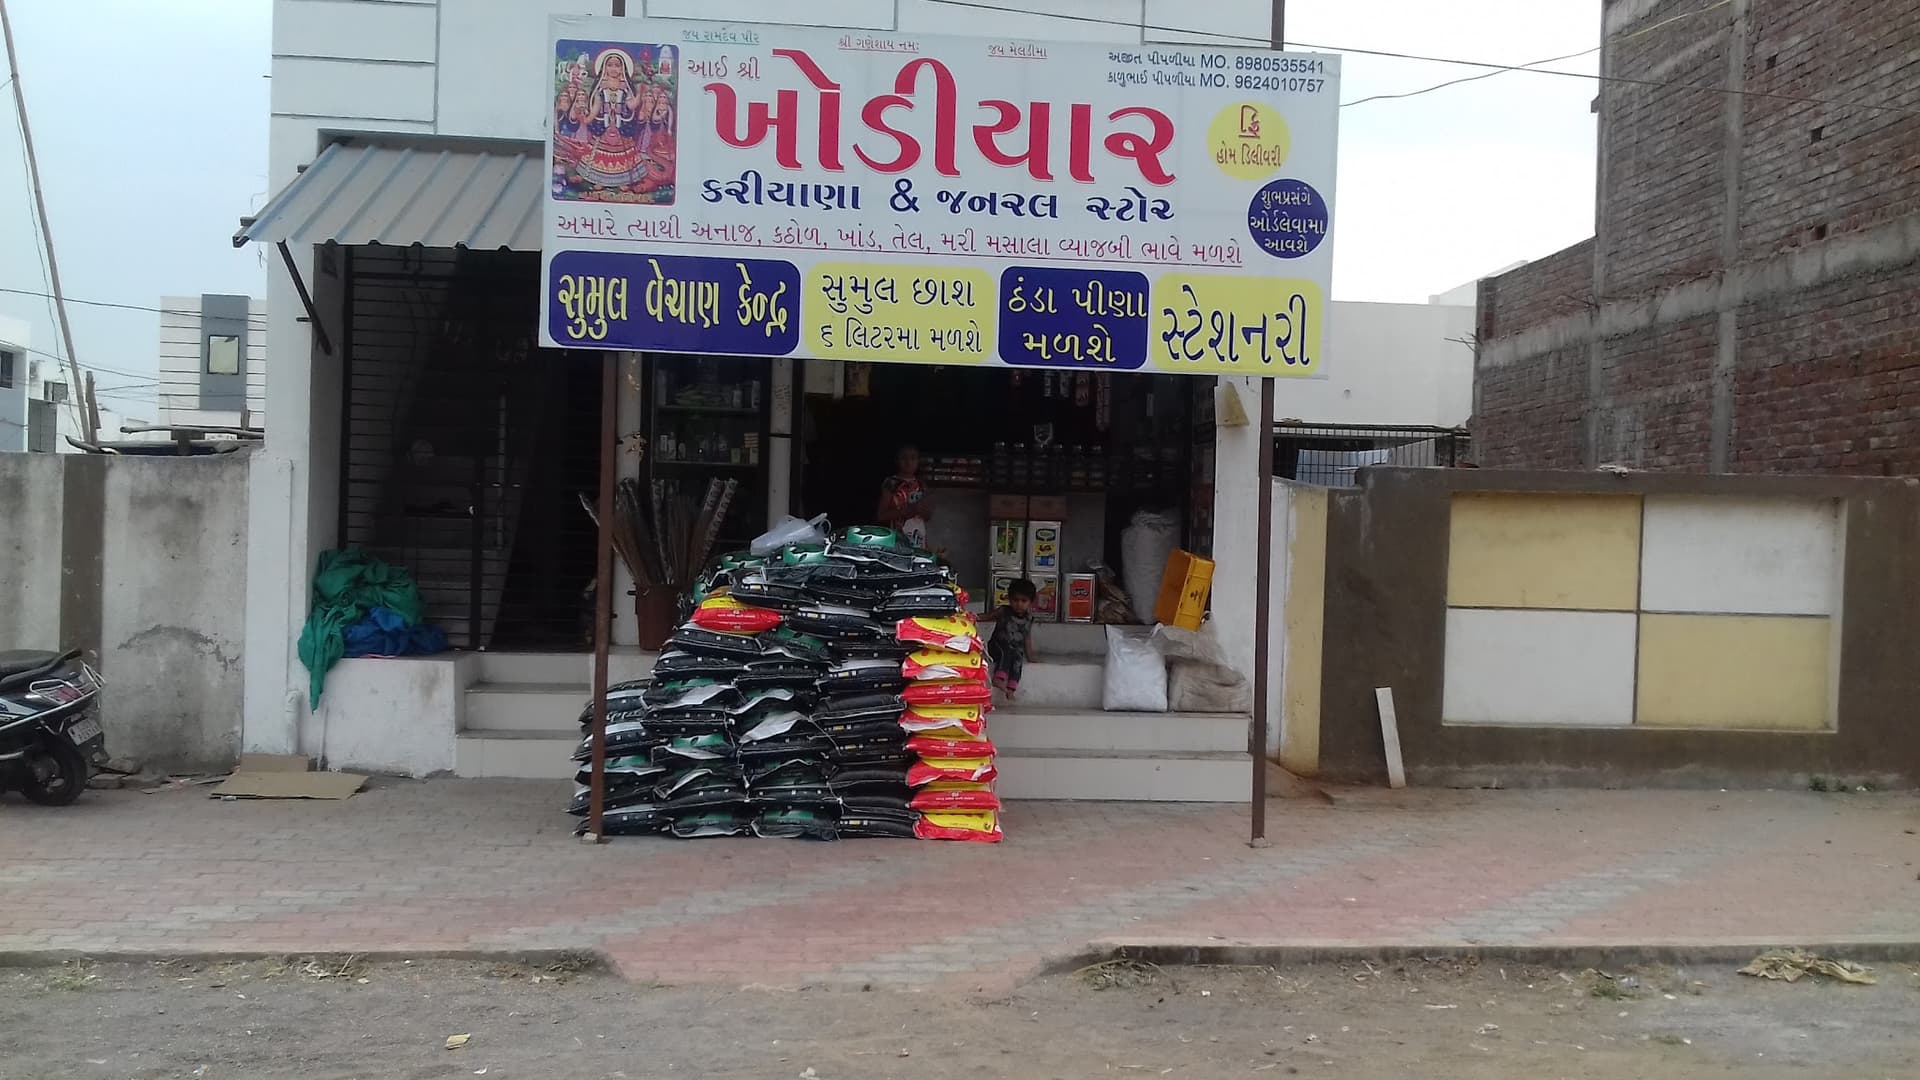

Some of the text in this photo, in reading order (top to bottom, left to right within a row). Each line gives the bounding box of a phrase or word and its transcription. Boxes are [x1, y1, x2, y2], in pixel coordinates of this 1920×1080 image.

[688, 55, 760, 79] આઈ શ્રી
[1200, 53, 1230, 70] MO.
[1235, 56, 1324, 75] 8980535541
[1200, 72, 1230, 88] MO.
[1235, 74, 1325, 93] 9624010757
[703, 48, 1176, 186] ખોડીયાર
[1216, 140, 1281, 167] હોમ ડિલીવરી
[701, 169, 1176, 223] કરીયાણા & જનરલ સ્ટોર
[557, 210, 617, 237] અમારે
[627, 215, 681, 240] ત્યાથી
[691, 221, 763, 247] અનાજ,
[941, 227, 976, 253] મરી
[986, 234, 1051, 256] મસાલા
[1058, 234, 1132, 260] વ્યાજબી
[1141, 239, 1183, 262] ભાવે
[1192, 237, 1243, 264] મળશે
[1264, 234, 1309, 253] આવશે
[558, 258, 789, 340] સુમુલ વેચાણ કેન્દ્ર
[821, 273, 976, 315] સુમુલ છાશ
[1007, 276, 1149, 318] ઠંડા પીણા
[845, 316, 921, 351] લિટરમા
[929, 320, 983, 354] મળશે
[1022, 323, 1117, 364] મળશે
[1161, 284, 1311, 367] સ્ટેશનરી
